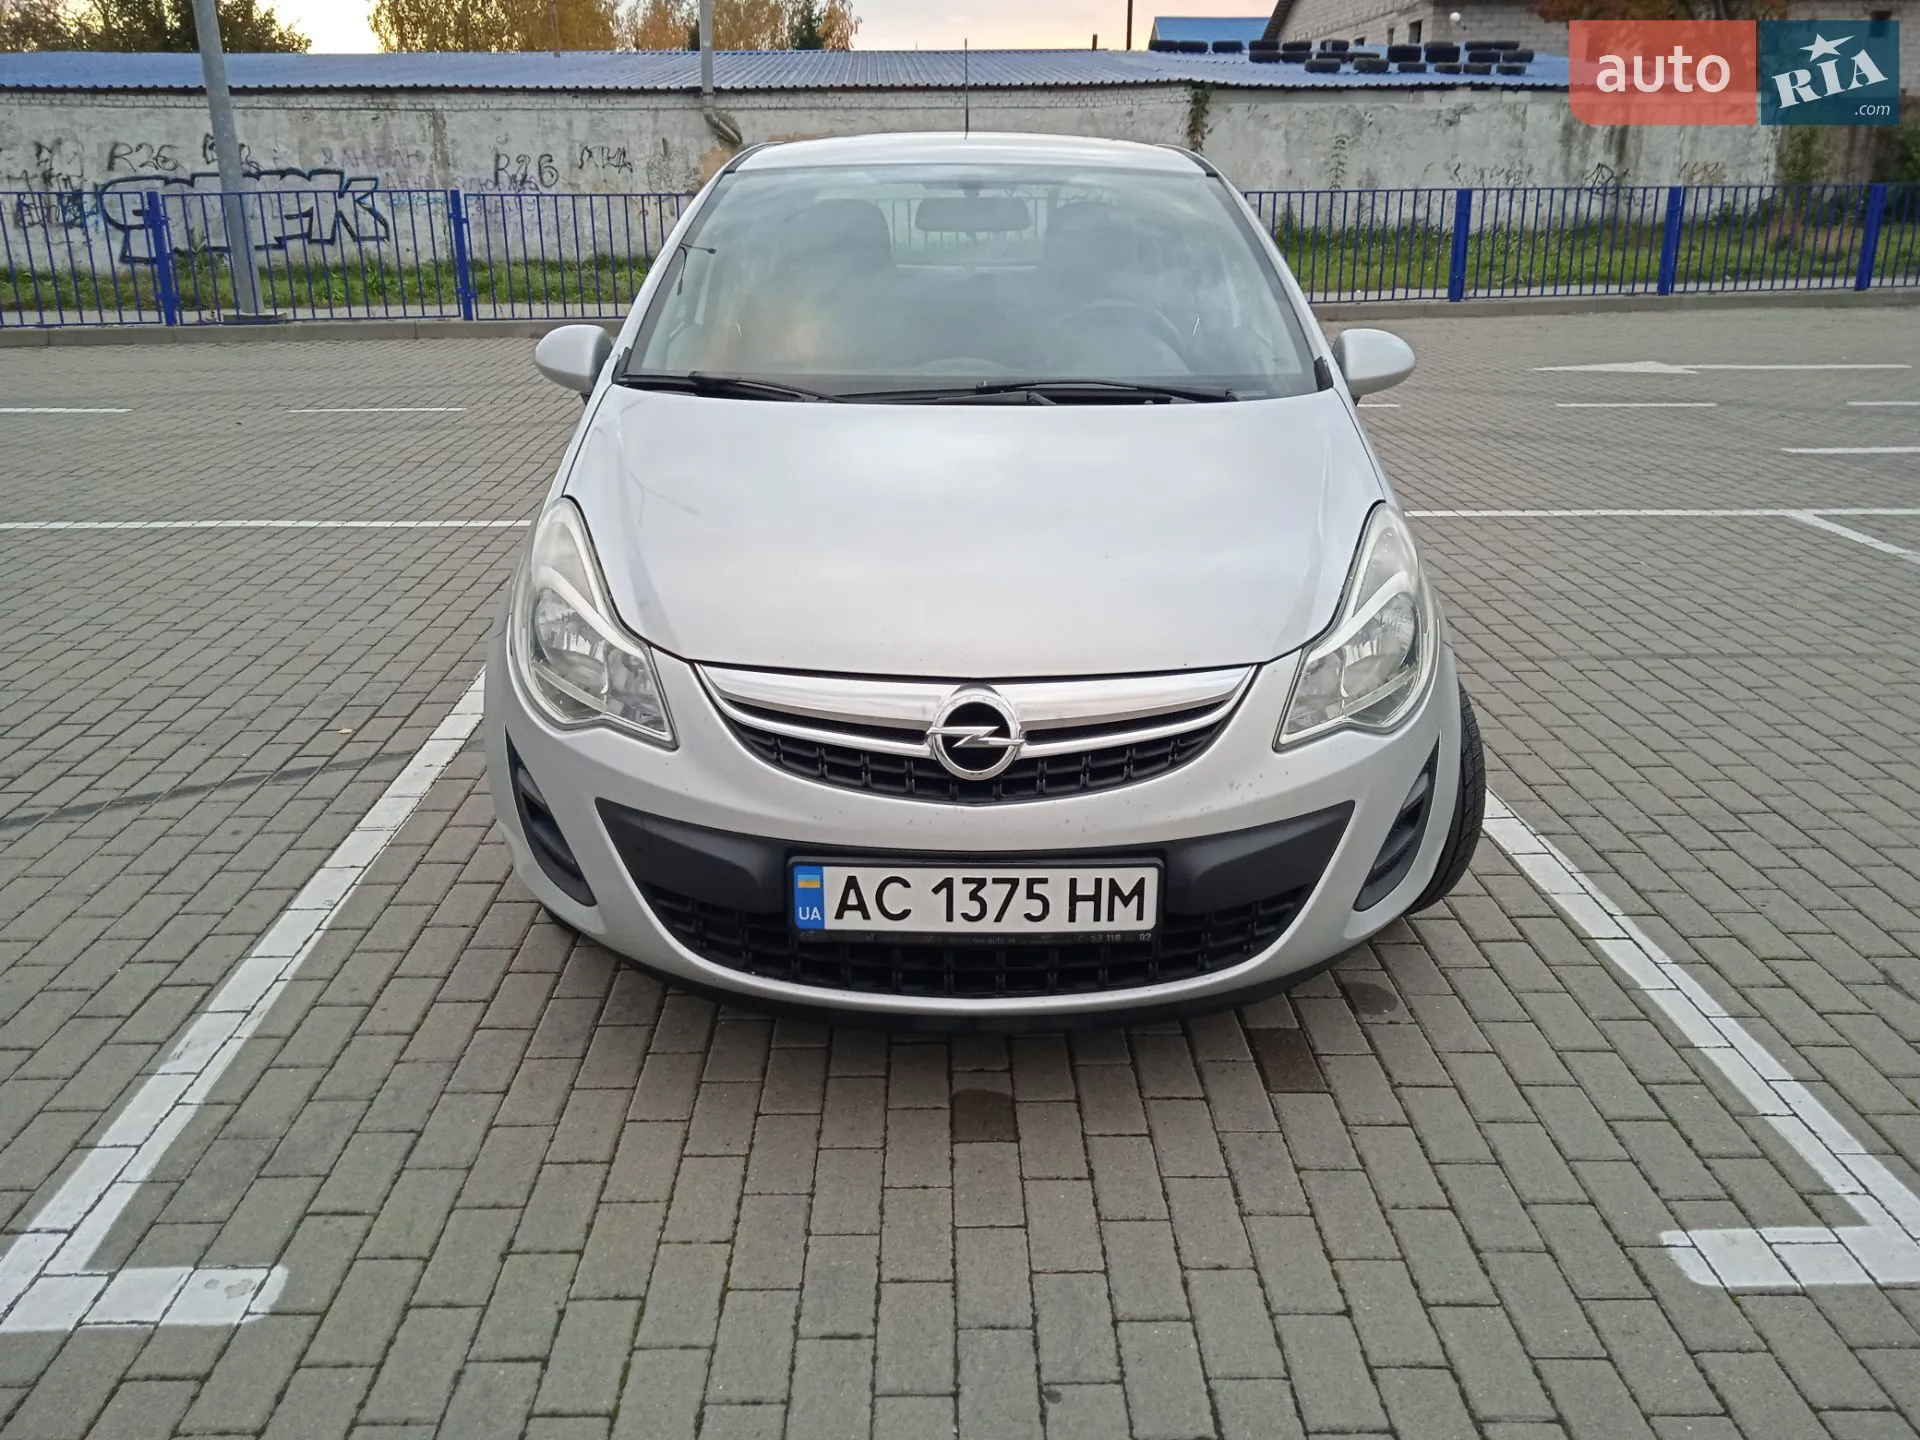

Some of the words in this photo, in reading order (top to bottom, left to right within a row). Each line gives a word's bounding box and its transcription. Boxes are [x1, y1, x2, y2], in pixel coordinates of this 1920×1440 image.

[493, 152, 560, 188] R26
[798, 906, 822, 921] UA
[834, 875, 912, 921] AC
[931, 877, 1051, 923] 1375
[1067, 877, 1146, 923] HM
